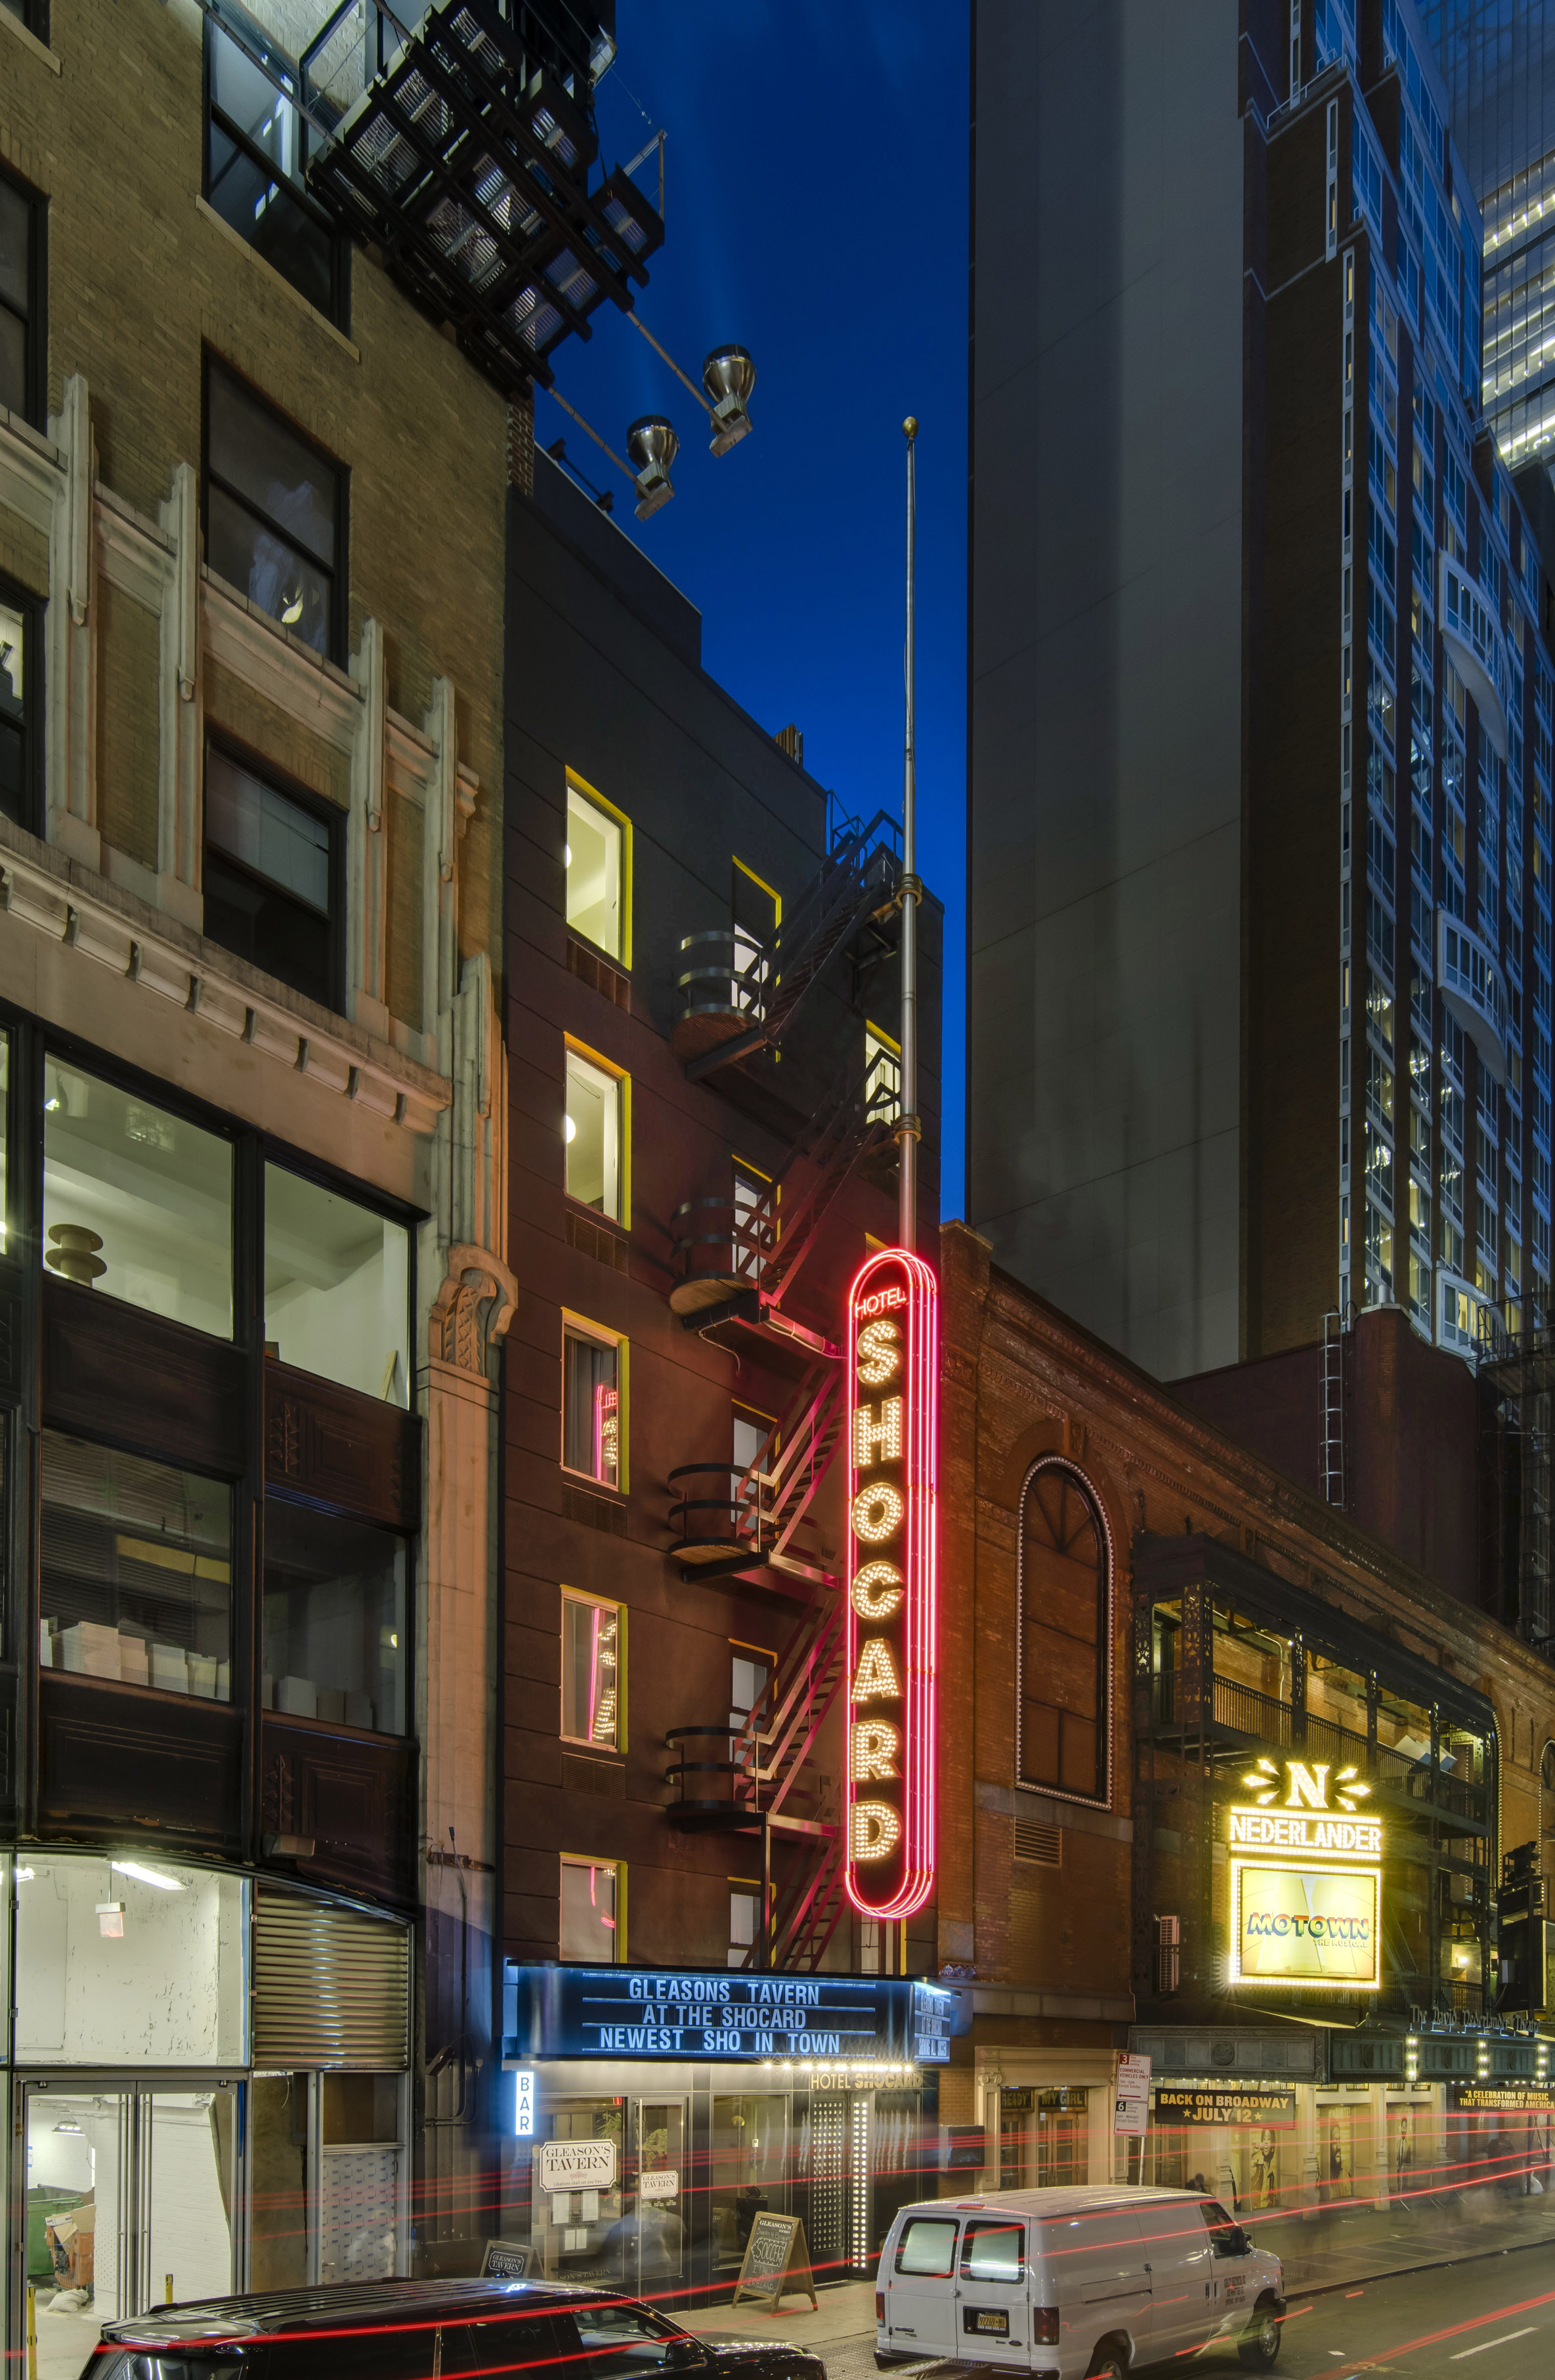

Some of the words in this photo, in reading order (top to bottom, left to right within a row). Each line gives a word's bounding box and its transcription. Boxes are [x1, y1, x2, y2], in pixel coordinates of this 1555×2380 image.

[855, 1287, 906, 1318] HOTEL
[851, 1320, 906, 1863] SHOCARD
[1285, 1762, 1330, 1809] N
[1229, 1815, 1381, 1851] NEDERLANDER
[1247, 1912, 1369, 1940] MOTOWN
[1332, 1939, 1369, 1948] MUSICAL
[629, 1978, 730, 2002] GLEASONS
[748, 1983, 819, 2005] TAVERN
[643, 2004, 668, 2025] AT
[676, 2006, 713, 2026] THE
[722, 2006, 806, 2029] SHOCARD
[1410, 2004, 1428, 2023] The
[1432, 2006, 1457, 2025] David
[1462, 2010, 1508, 2031] Nederlander
[601, 2027, 684, 2050] NEWEST
[704, 2030, 740, 2050] SHO
[756, 2033, 773, 2052] IN
[788, 2033, 840, 2054] TOWN
[1122, 2055, 1128, 2064] 3
[811, 2073, 851, 2089] HOTEL
[854, 2073, 924, 2089] SHOCARD
[1161, 2094, 1193, 2106] BACK
[1197, 2094, 1212, 2106] ON
[1216, 2096, 1289, 2109] BROADWAY
[1460, 2098, 1476, 2106] THAT
[1477, 2099, 1524, 2108] TRANSFORMED
[1474, 2090, 1516, 2100] CELEBRATION
[1518, 2092, 1526, 2100] OF
[1527, 2092, 1549, 2101] MUSIC
[520, 2077, 530, 2130] BAR
[1118, 2102, 1124, 2111] 6
[1193, 2108, 1232, 2121] JULY
[1237, 2109, 1252, 2123] 12
[546, 2146, 610, 2157] GLEASON'S
[546, 2156, 609, 2171] TAVERN
[643, 2180, 675, 2188] TAVERN
[759, 2220, 792, 2230] GLEASON'S
[492, 2255, 521, 2264] GLEASON'S
[756, 2241, 783, 2263] SOCCER
[492, 2261, 520, 2271] TAVERN
[582, 2269, 611, 2278] TAVERN
[752, 2264, 775, 2277] ITALY
[747, 2278, 773, 2291] IRELAND
